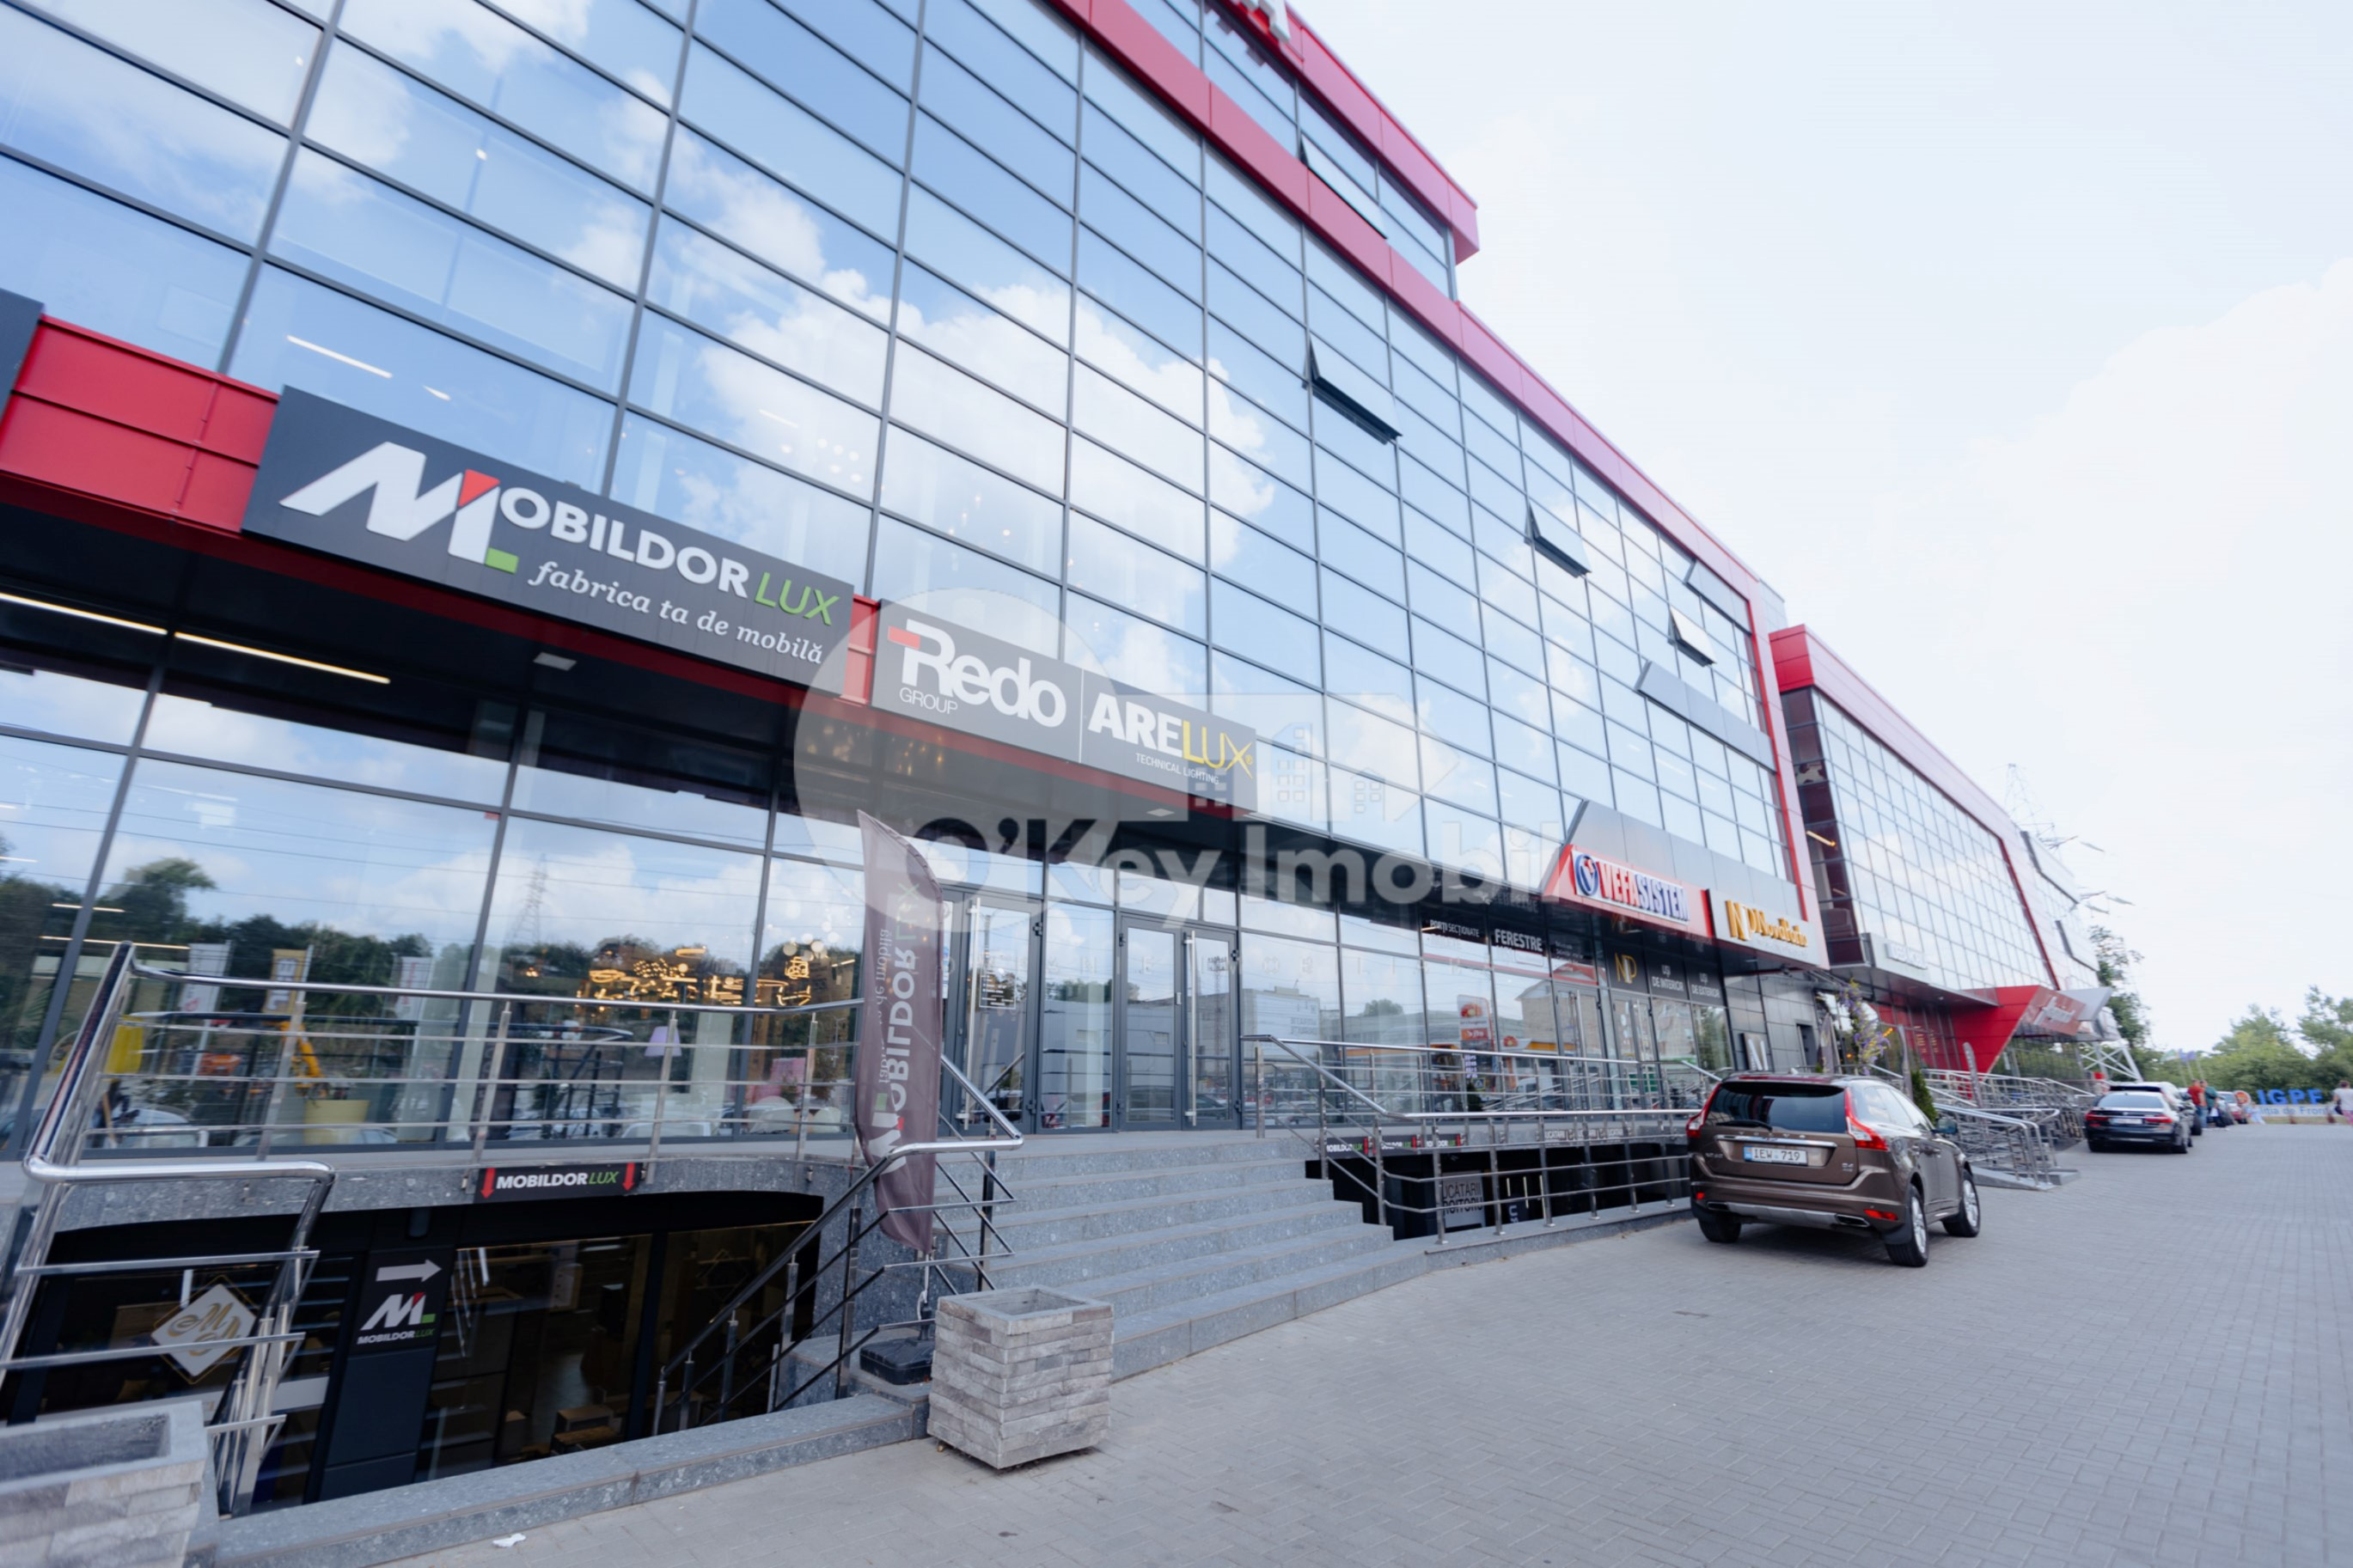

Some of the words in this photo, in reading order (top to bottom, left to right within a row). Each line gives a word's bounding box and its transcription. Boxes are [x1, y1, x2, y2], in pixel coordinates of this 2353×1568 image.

[754, 571, 840, 626] LUX
[528, 560, 651, 614] fabrica
[659, 599, 688, 625] ta
[697, 611, 729, 637] de
[736, 625, 824, 665] mobilă
[888, 618, 1067, 729] Redo
[899, 686, 958, 716] GROUP
[1135, 752, 1183, 775] TECHNICAL
[1183, 766, 1219, 785] LIGHTING
[1494, 928, 1543, 952] FERESTRE
[2256, 1088, 2323, 1106] IGPF
[1754, 1149, 1772, 1159] IEW
[1782, 1150, 1800, 1161] 719
[496, 1173, 588, 1190] MOBILDOR
[589, 1171, 619, 1185] LUX
[1443, 1197, 1483, 1215] ROITORU
[357, 1330, 415, 1345] MOBILDOR
[415, 1328, 436, 1339] LUX
